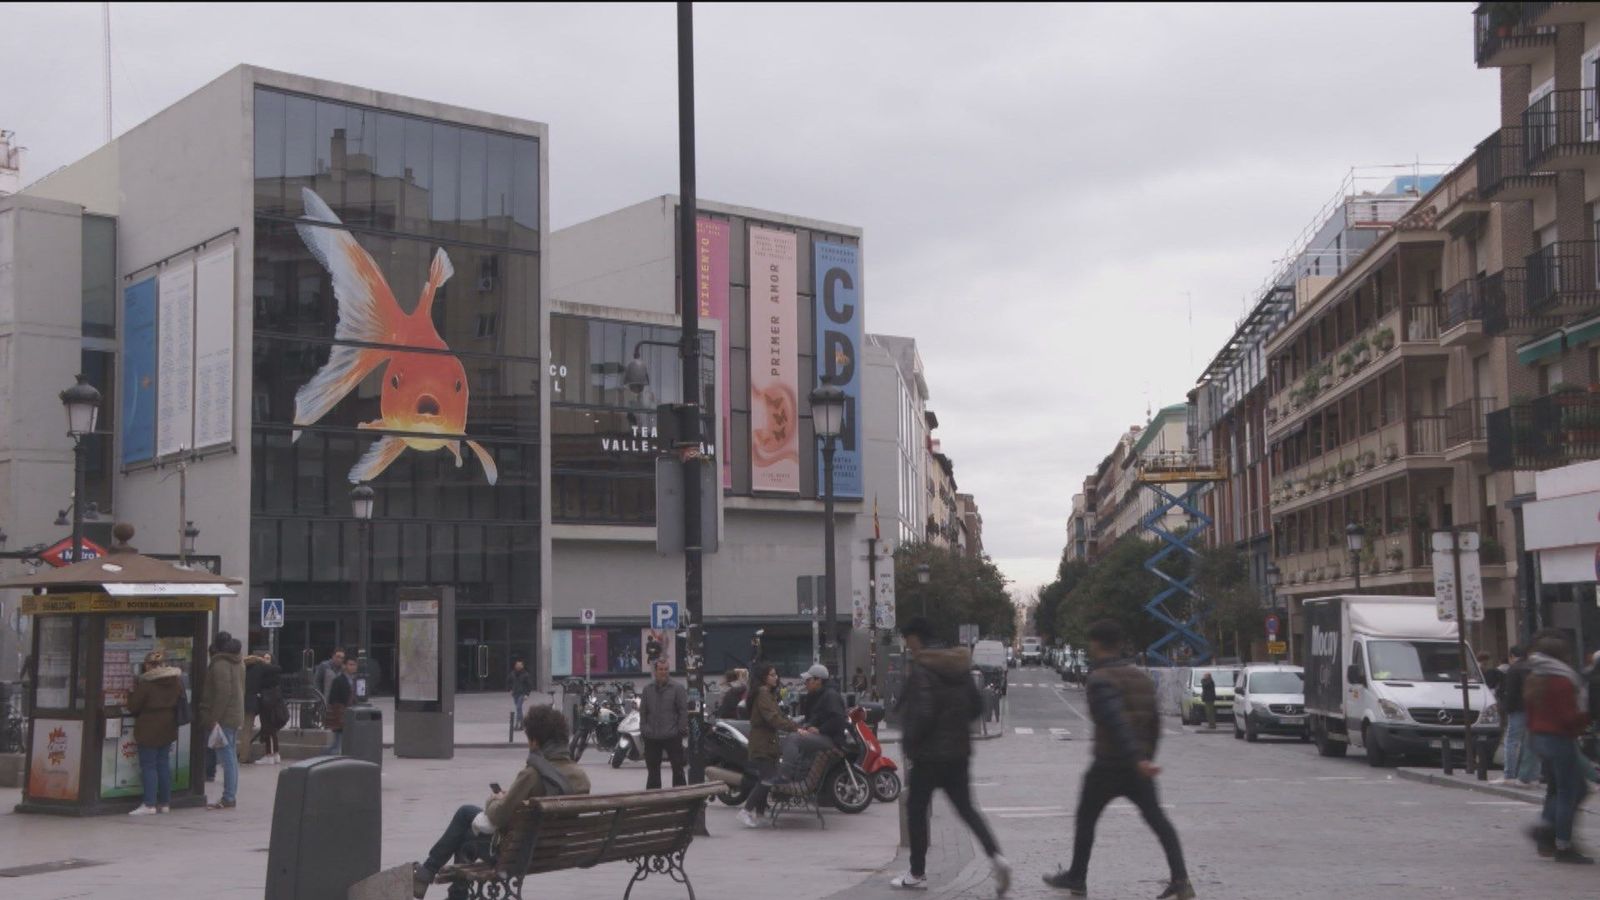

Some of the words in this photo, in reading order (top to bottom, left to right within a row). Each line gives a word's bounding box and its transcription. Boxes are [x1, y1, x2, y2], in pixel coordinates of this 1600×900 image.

[769, 263, 780, 305] AMOR
[770, 315, 781, 377] PRIMER
[631, 425, 658, 439] TEA
[65, 550, 95, 561] Mtro
[656, 604, 674, 628] P
